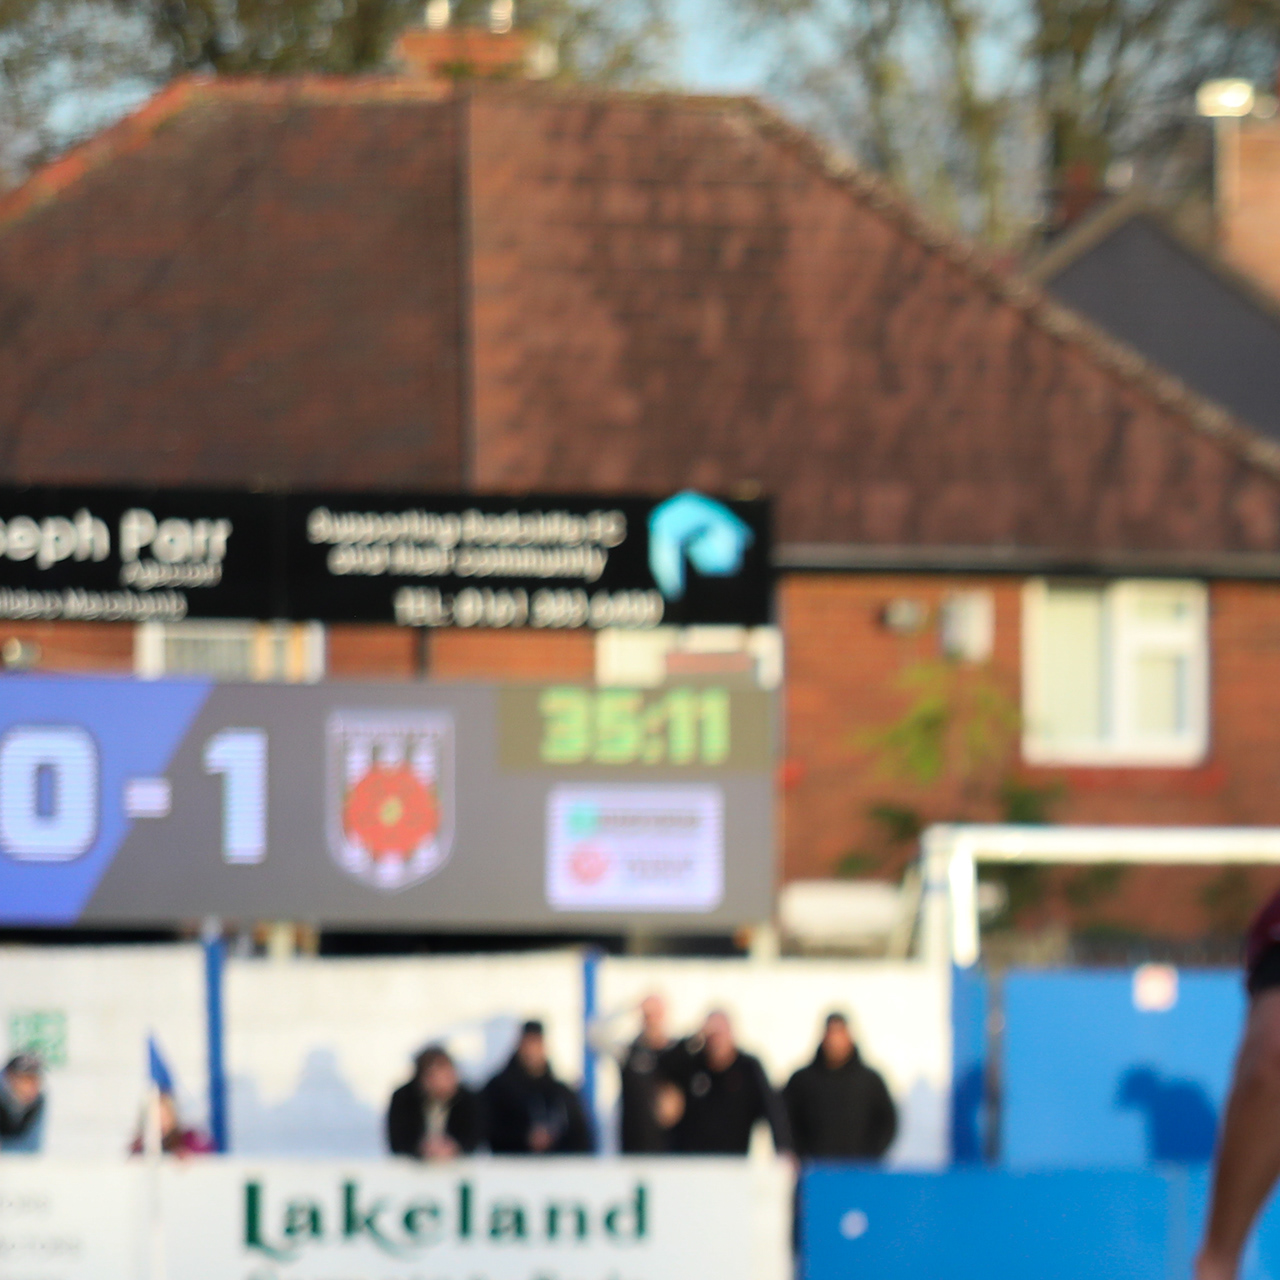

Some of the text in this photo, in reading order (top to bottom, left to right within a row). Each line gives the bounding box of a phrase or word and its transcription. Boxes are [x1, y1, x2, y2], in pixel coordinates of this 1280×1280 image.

[119, 507, 233, 562] Parr
[540, 685, 731, 765] 35:11
[2, 725, 98, 862] 0
[204, 728, 269, 864] 1
[242, 1177, 650, 1262] Lakeland
